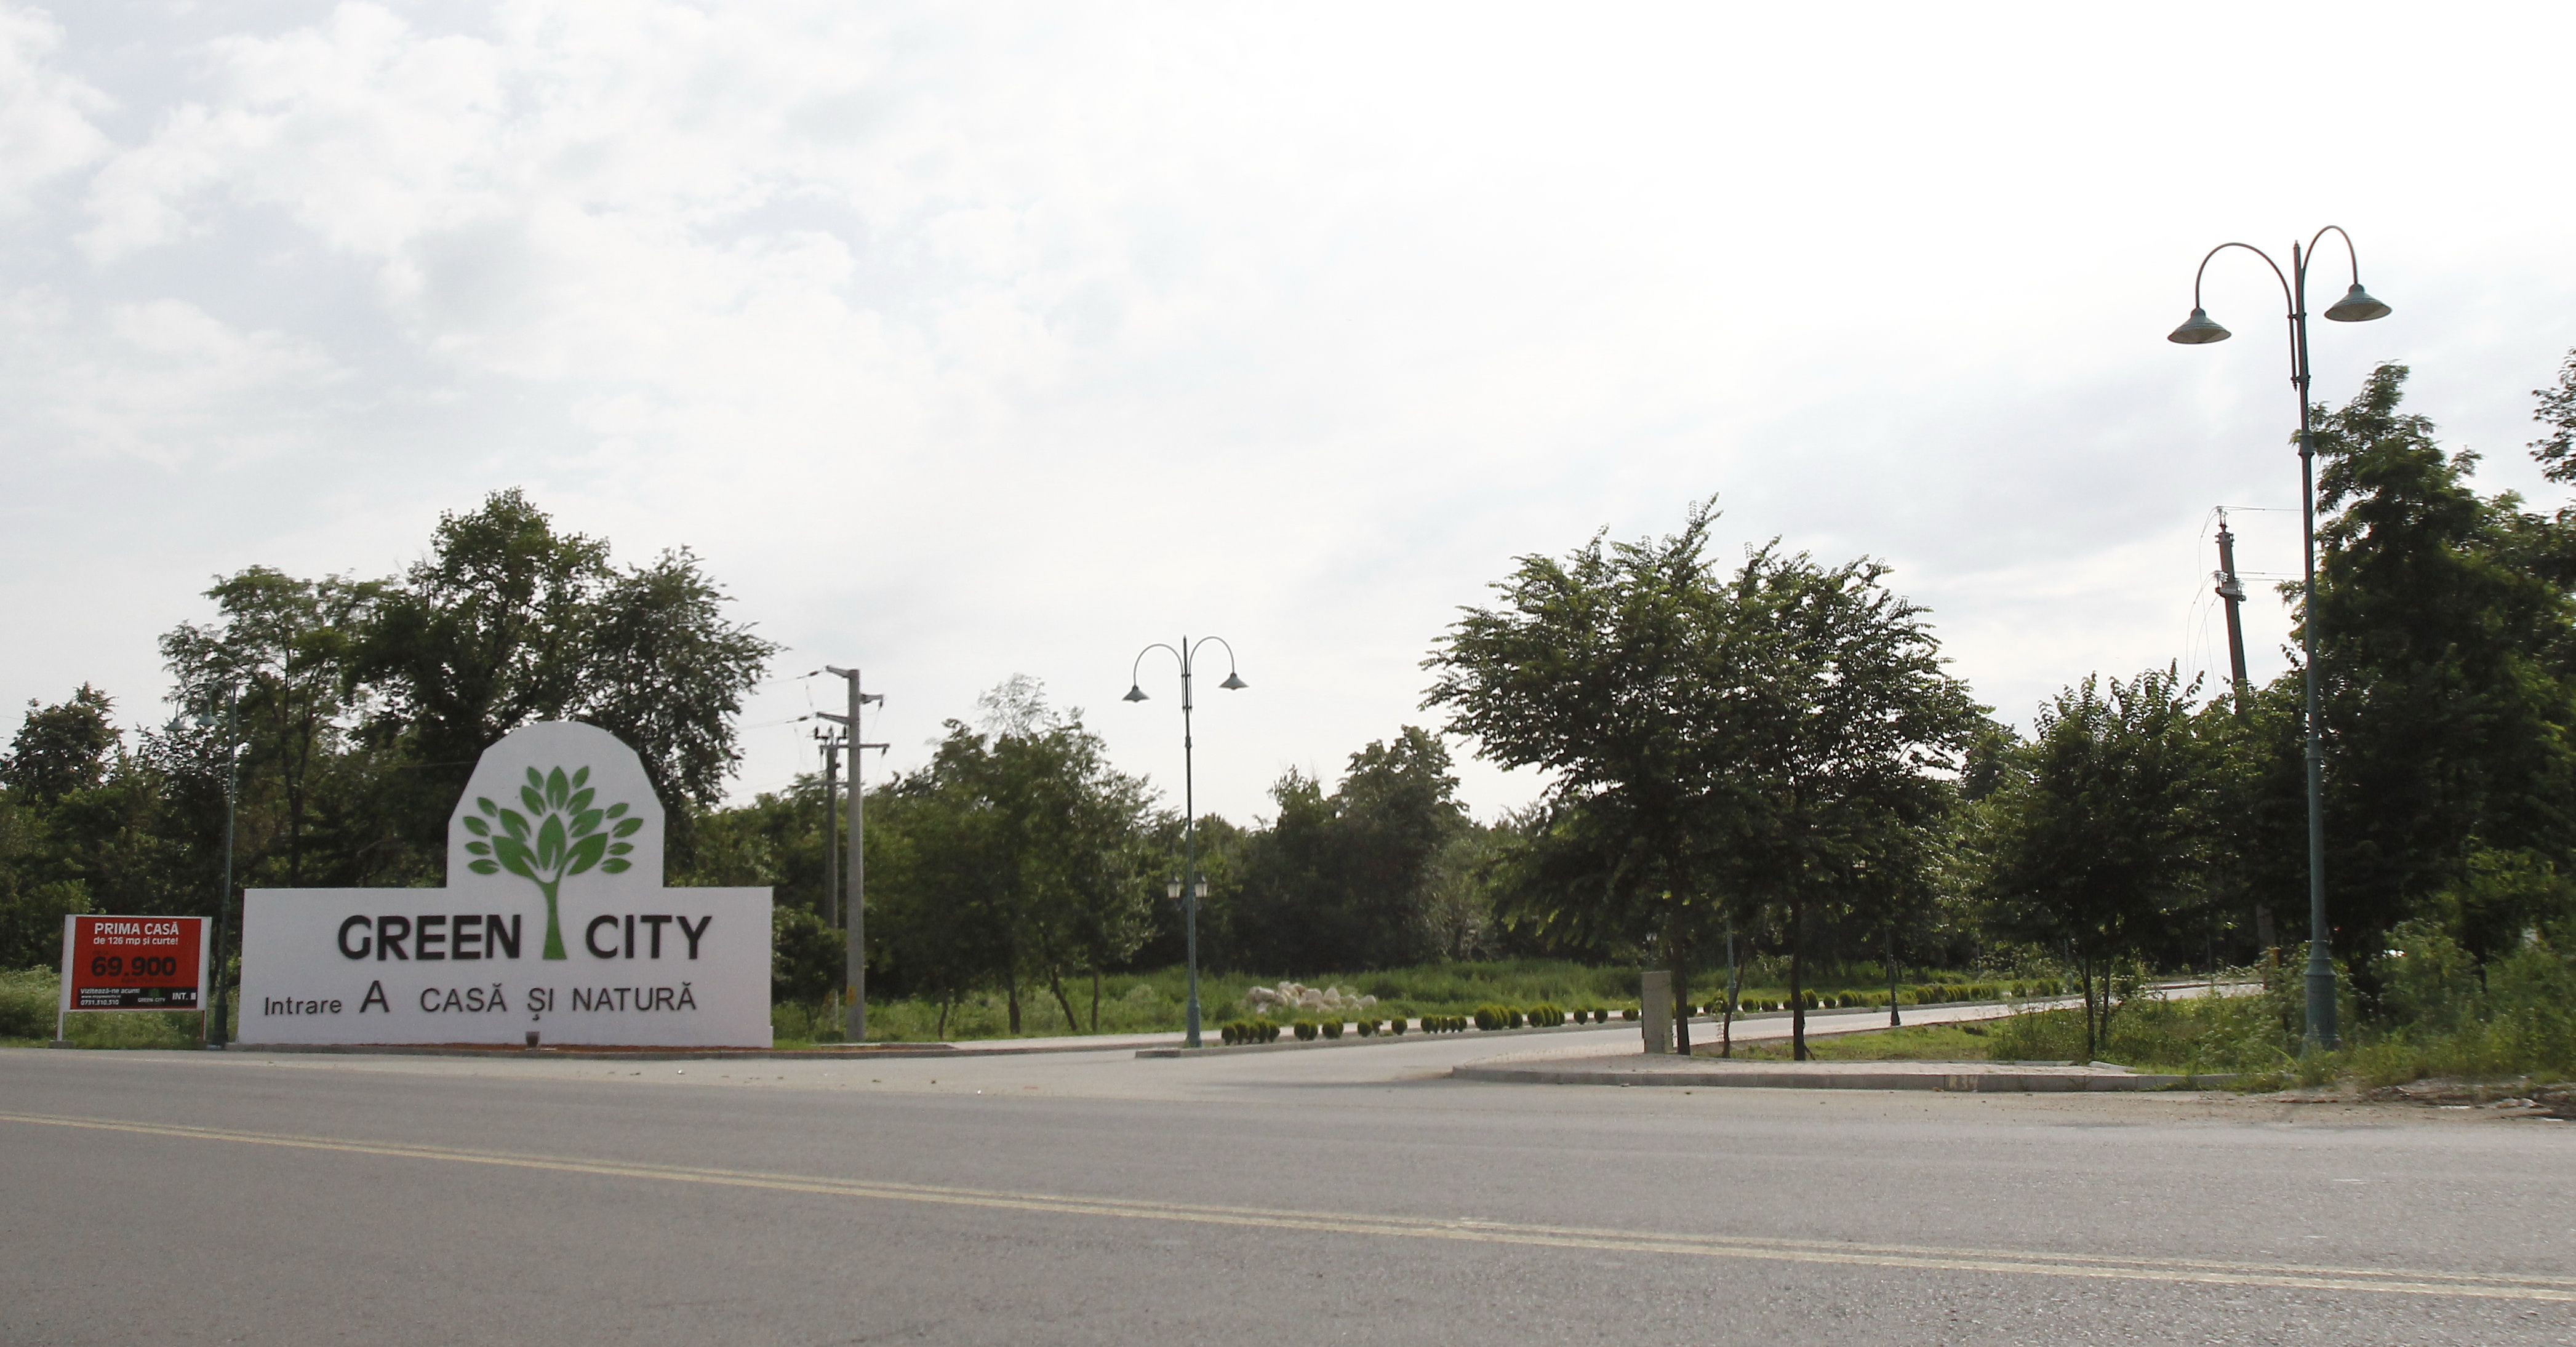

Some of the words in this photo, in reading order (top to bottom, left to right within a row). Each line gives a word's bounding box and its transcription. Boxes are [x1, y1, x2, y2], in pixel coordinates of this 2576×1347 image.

[94, 922, 140, 935] PRIMA
[144, 921, 179, 935] CASĂ
[338, 914, 521, 961] GREEN
[585, 914, 712, 959] CITY
[92, 956, 177, 977] 69.900
[265, 996, 342, 1015] Intrare
[359, 980, 390, 1013] A
[420, 983, 508, 1013] CASĂ
[527, 987, 553, 1021] ȘI
[572, 981, 697, 1012] NATURĂ
